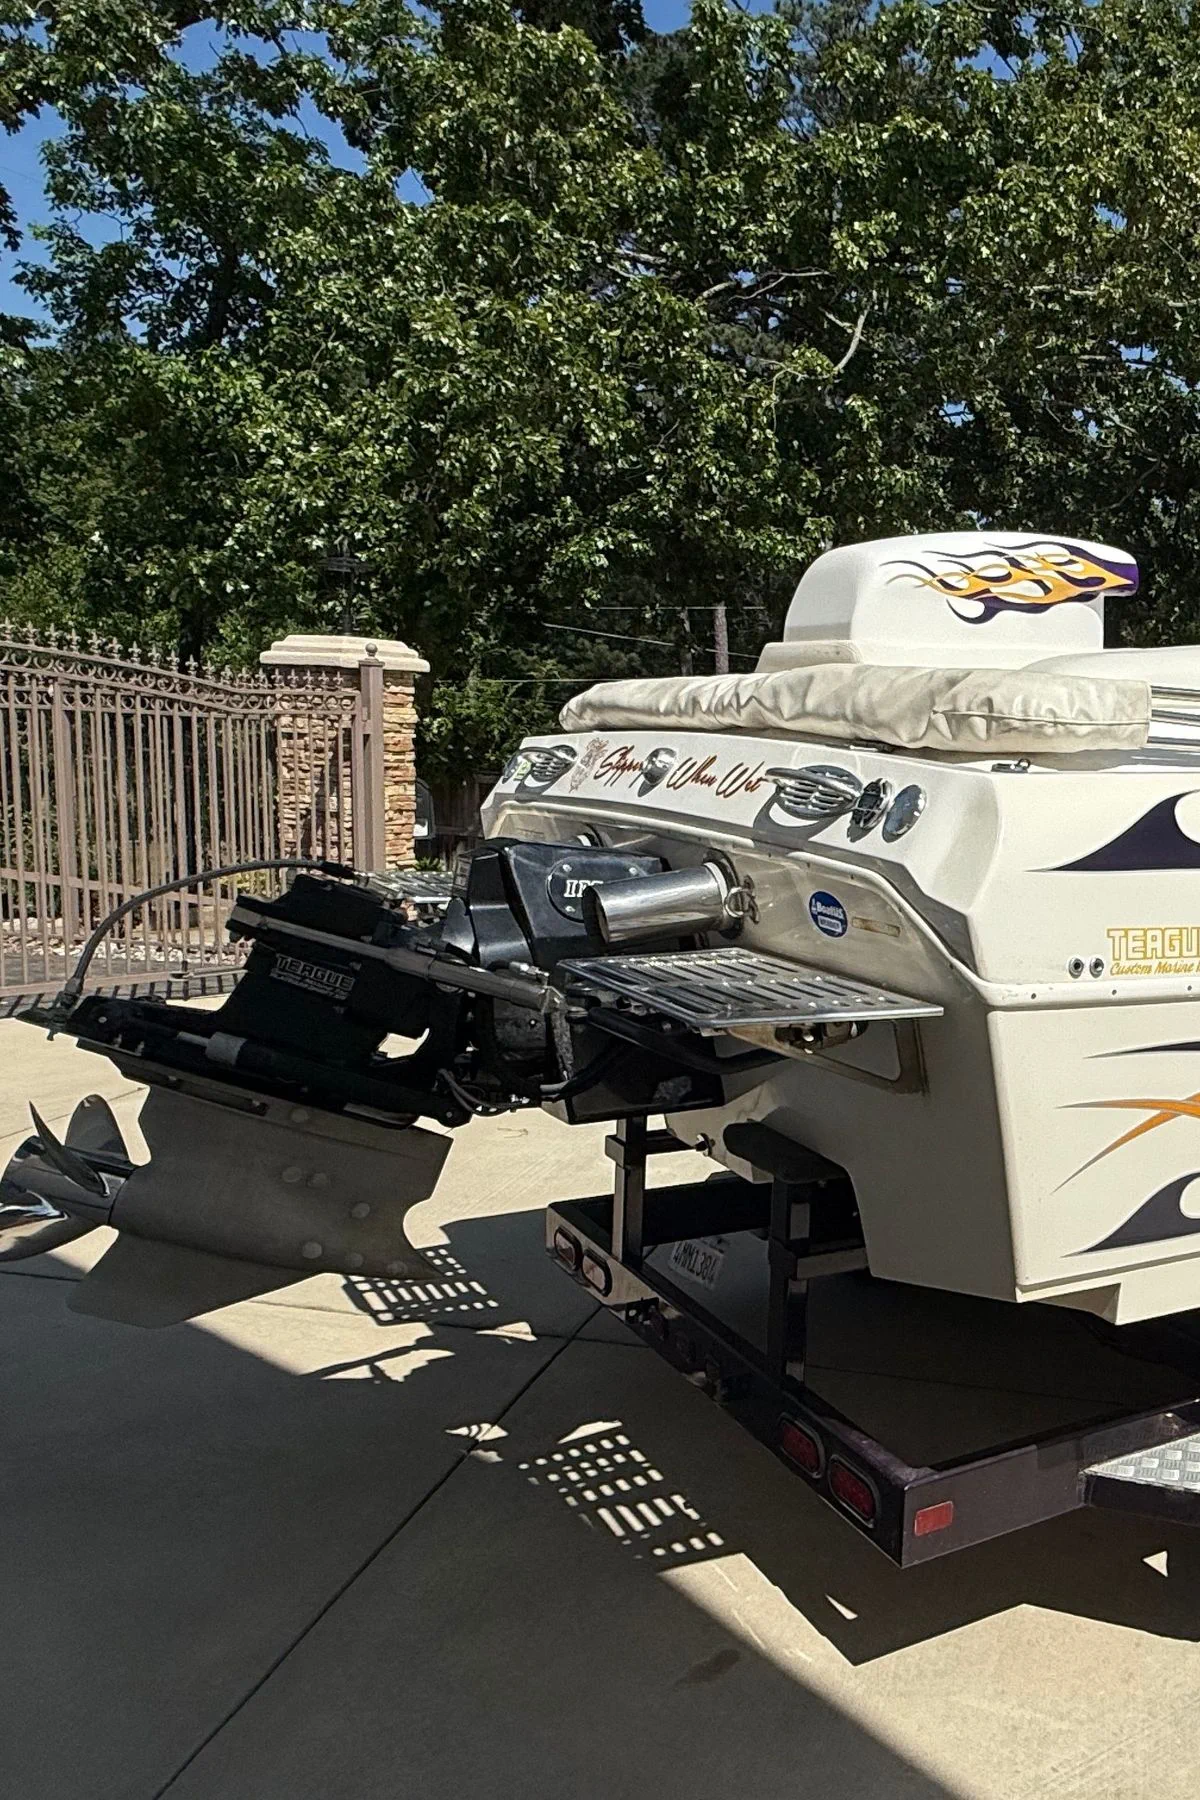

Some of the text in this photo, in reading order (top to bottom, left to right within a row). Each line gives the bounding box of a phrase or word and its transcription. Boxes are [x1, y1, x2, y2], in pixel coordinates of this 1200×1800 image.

[666, 754, 718, 791] When
[715, 760, 768, 799] Wet
[275, 953, 356, 991] TEAGUE
[1109, 961, 1152, 976] Custom
[1154, 960, 1194, 974] Marine
